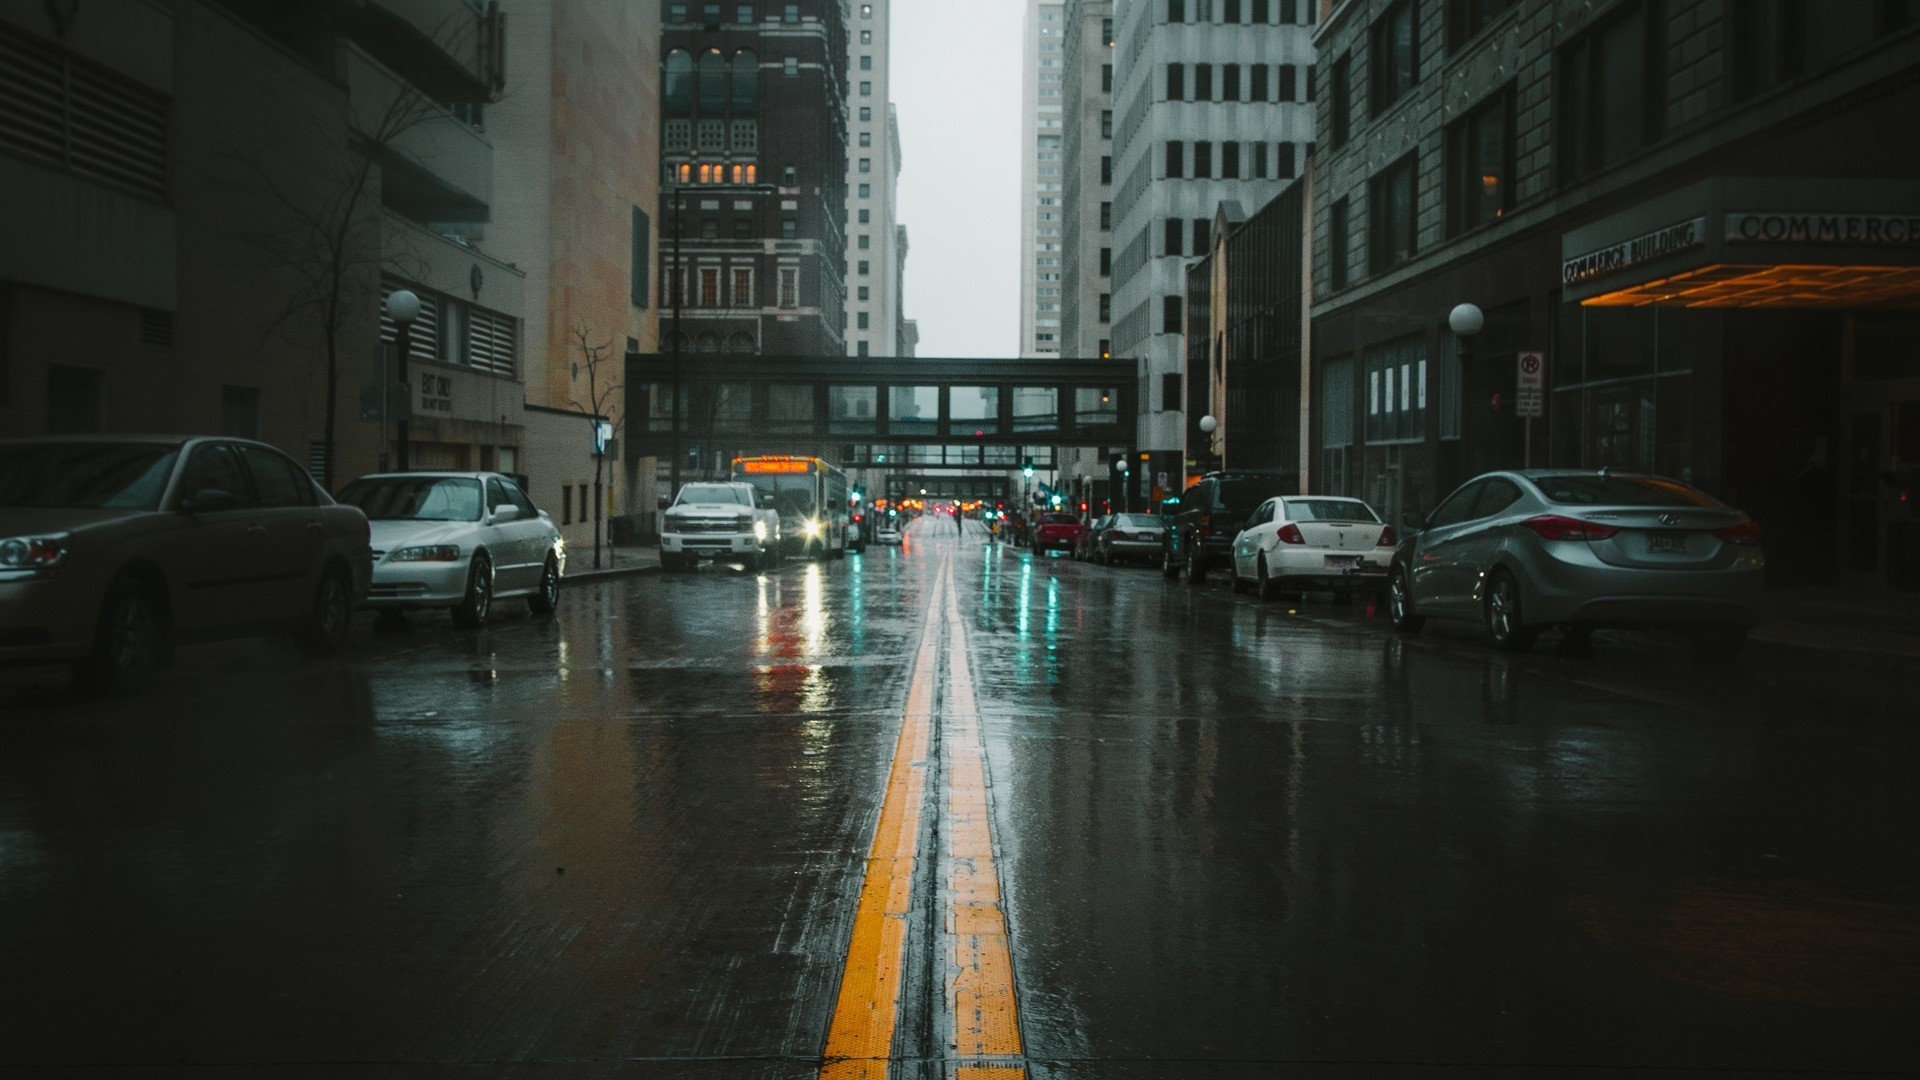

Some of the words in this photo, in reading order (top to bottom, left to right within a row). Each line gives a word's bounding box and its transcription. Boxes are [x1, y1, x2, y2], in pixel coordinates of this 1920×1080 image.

[1740, 216, 1920, 241] COMMERCE
[1564, 245, 1625, 281] COMMERCE
[1631, 222, 1695, 261] BUILDING
[422, 372, 436, 395] EXIT
[437, 376, 451, 397] ONLY
